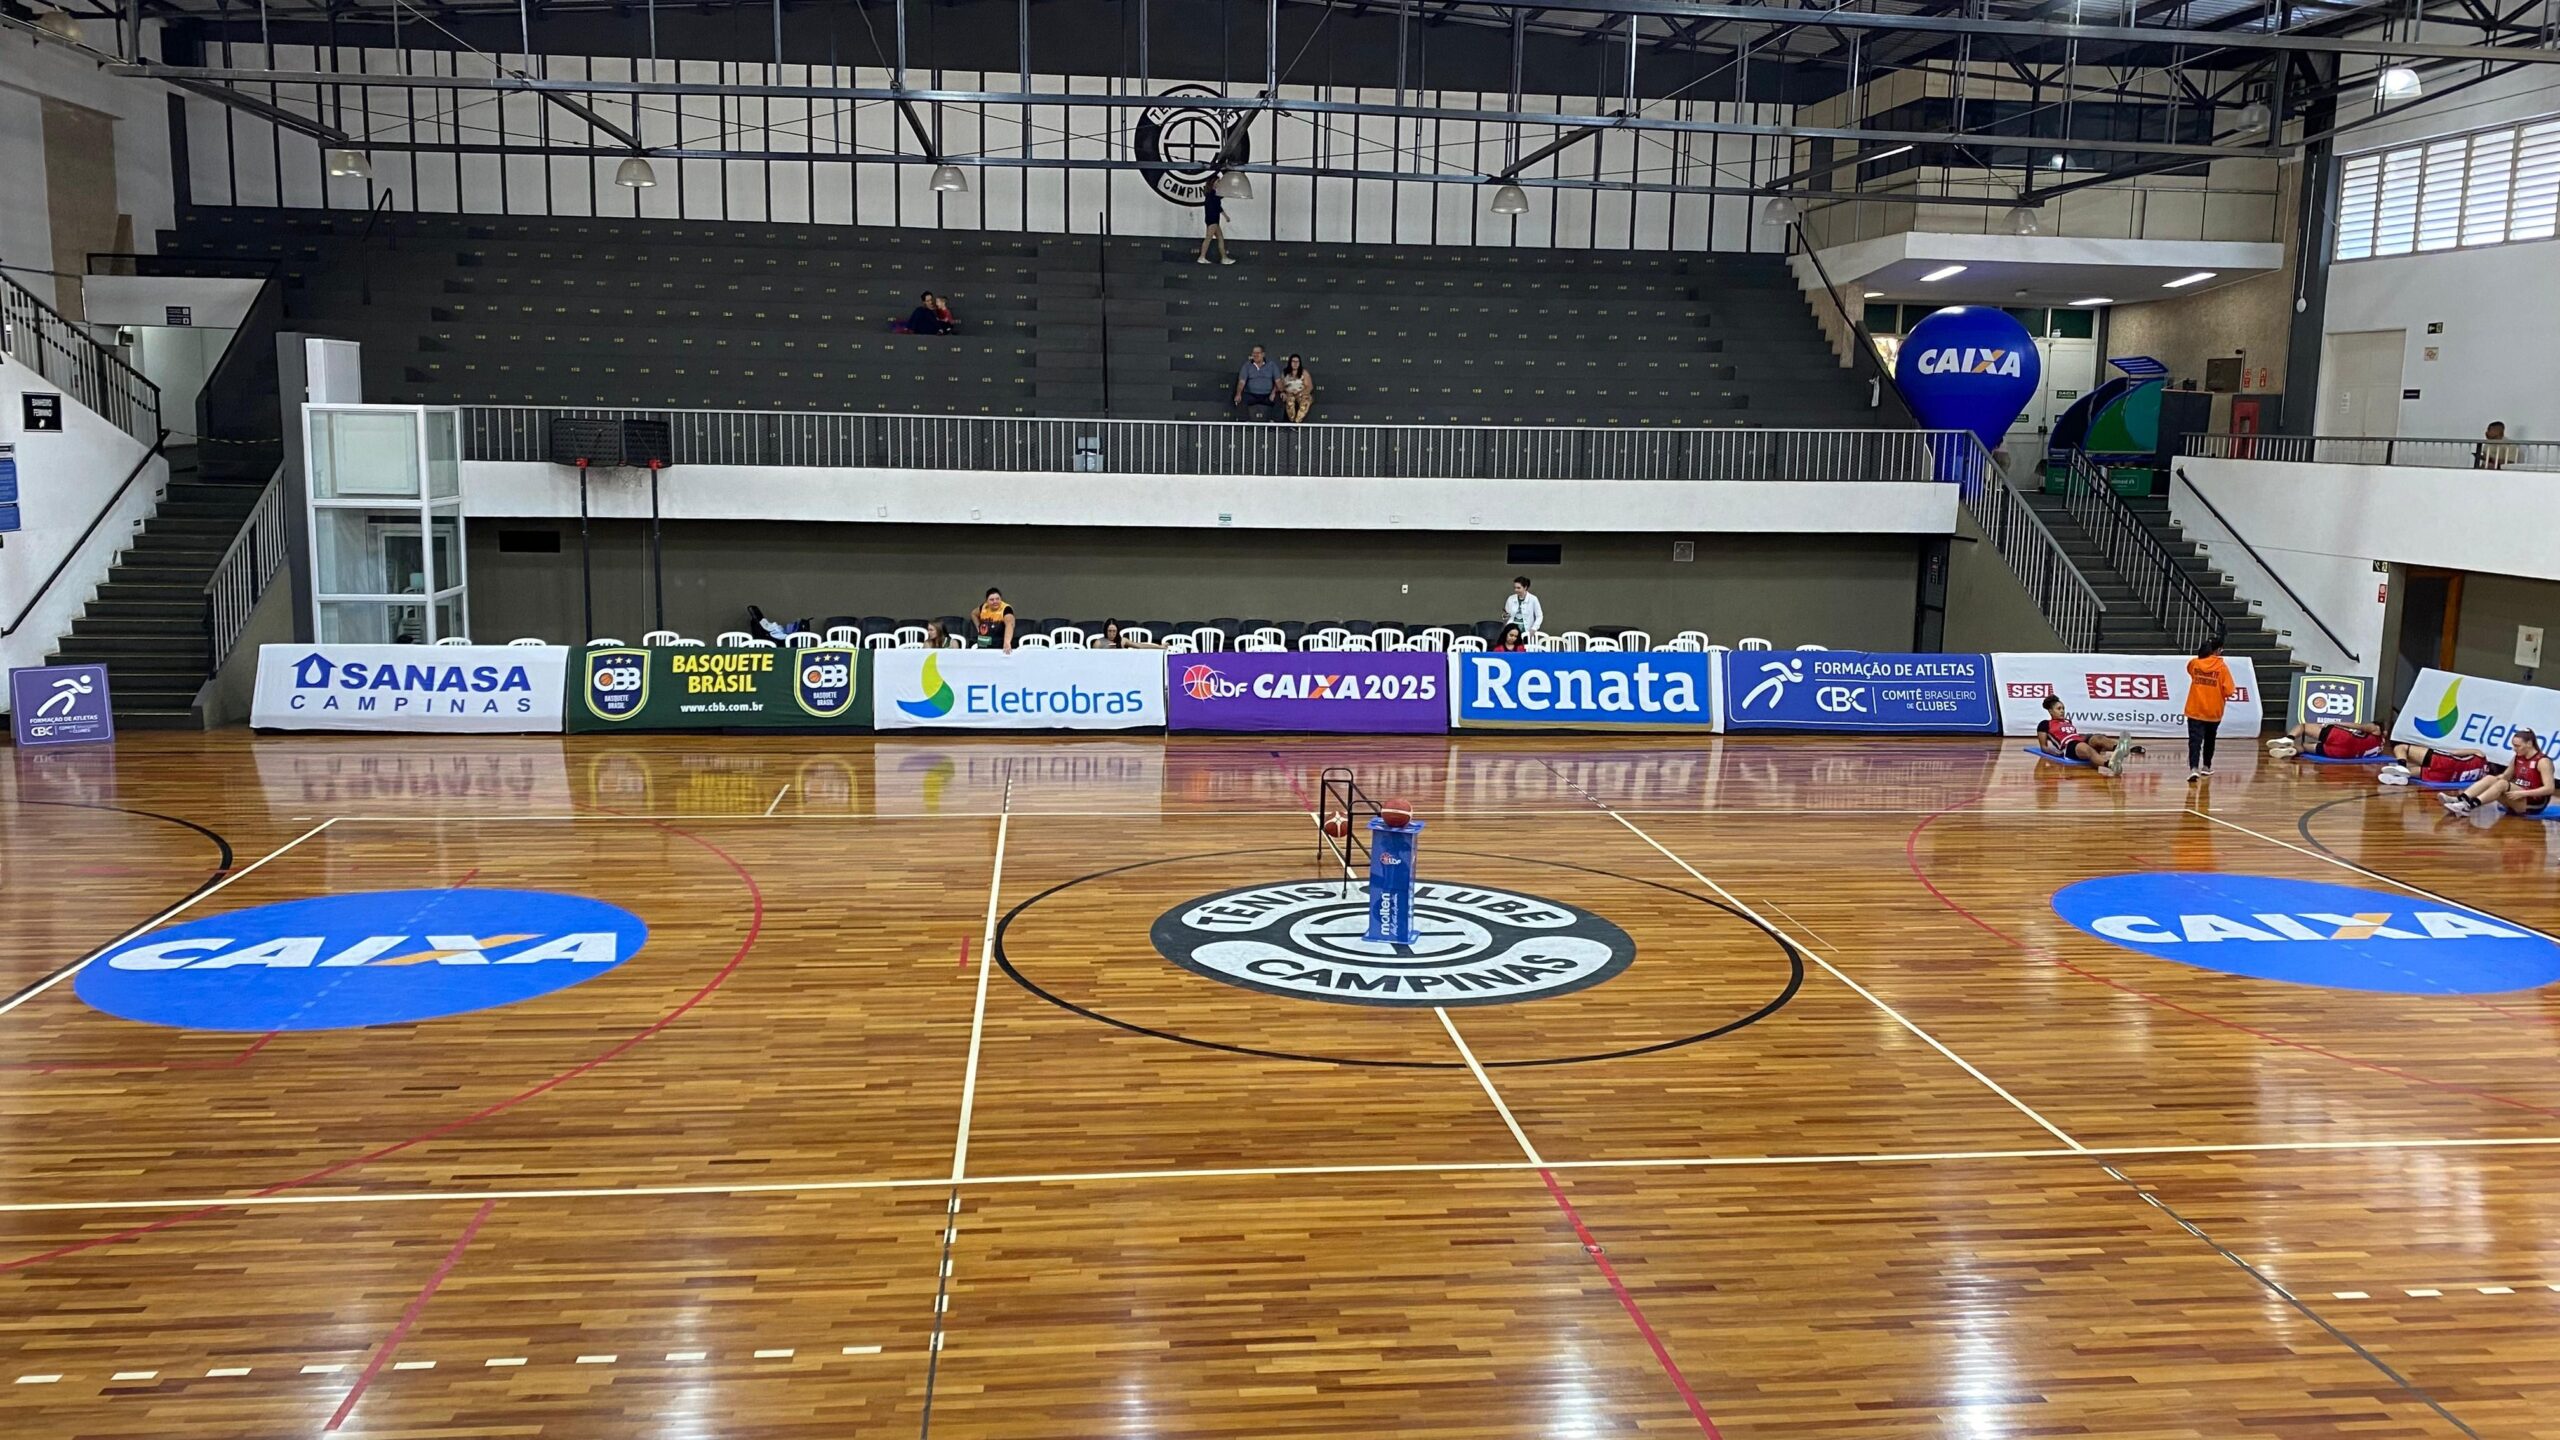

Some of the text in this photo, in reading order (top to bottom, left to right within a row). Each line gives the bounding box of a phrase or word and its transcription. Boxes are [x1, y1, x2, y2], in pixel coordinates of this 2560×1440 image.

[1163, 178, 1206, 199] CAMPIN
[1918, 348, 2020, 378] CAIXA
[672, 654, 773, 675] BASQUETE
[803, 664, 848, 688] CBB
[1814, 661, 1975, 679] FORMAÇÃO DE ATLETAS
[340, 662, 531, 692] SANASA
[594, 667, 641, 691] CBB
[688, 673, 756, 693] BRASIL
[1252, 674, 1361, 700] CAIXA
[1364, 675, 1436, 701] 2025
[1471, 657, 1700, 712] Renata
[2095, 677, 2159, 698] SESI
[290, 695, 531, 712] CAMPINAS
[967, 684, 1143, 714] Eletrobras
[1816, 686, 1868, 713] CBC
[1882, 688, 1976, 701] COMITÊ BRASILEIRO
[2012, 685, 2049, 698] SESI
[2307, 692, 2354, 715] CBB
[680, 702, 764, 712] www.cbb.com.br
[1915, 701, 1957, 711] CLUBES
[1196, 886, 1337, 924] TÊNIS
[1379, 892, 1391, 936] molten
[2091, 912, 2532, 944] CAIXA
[109, 932, 617, 971] CAIXA
[1246, 954, 1578, 994] CAMPINAS
